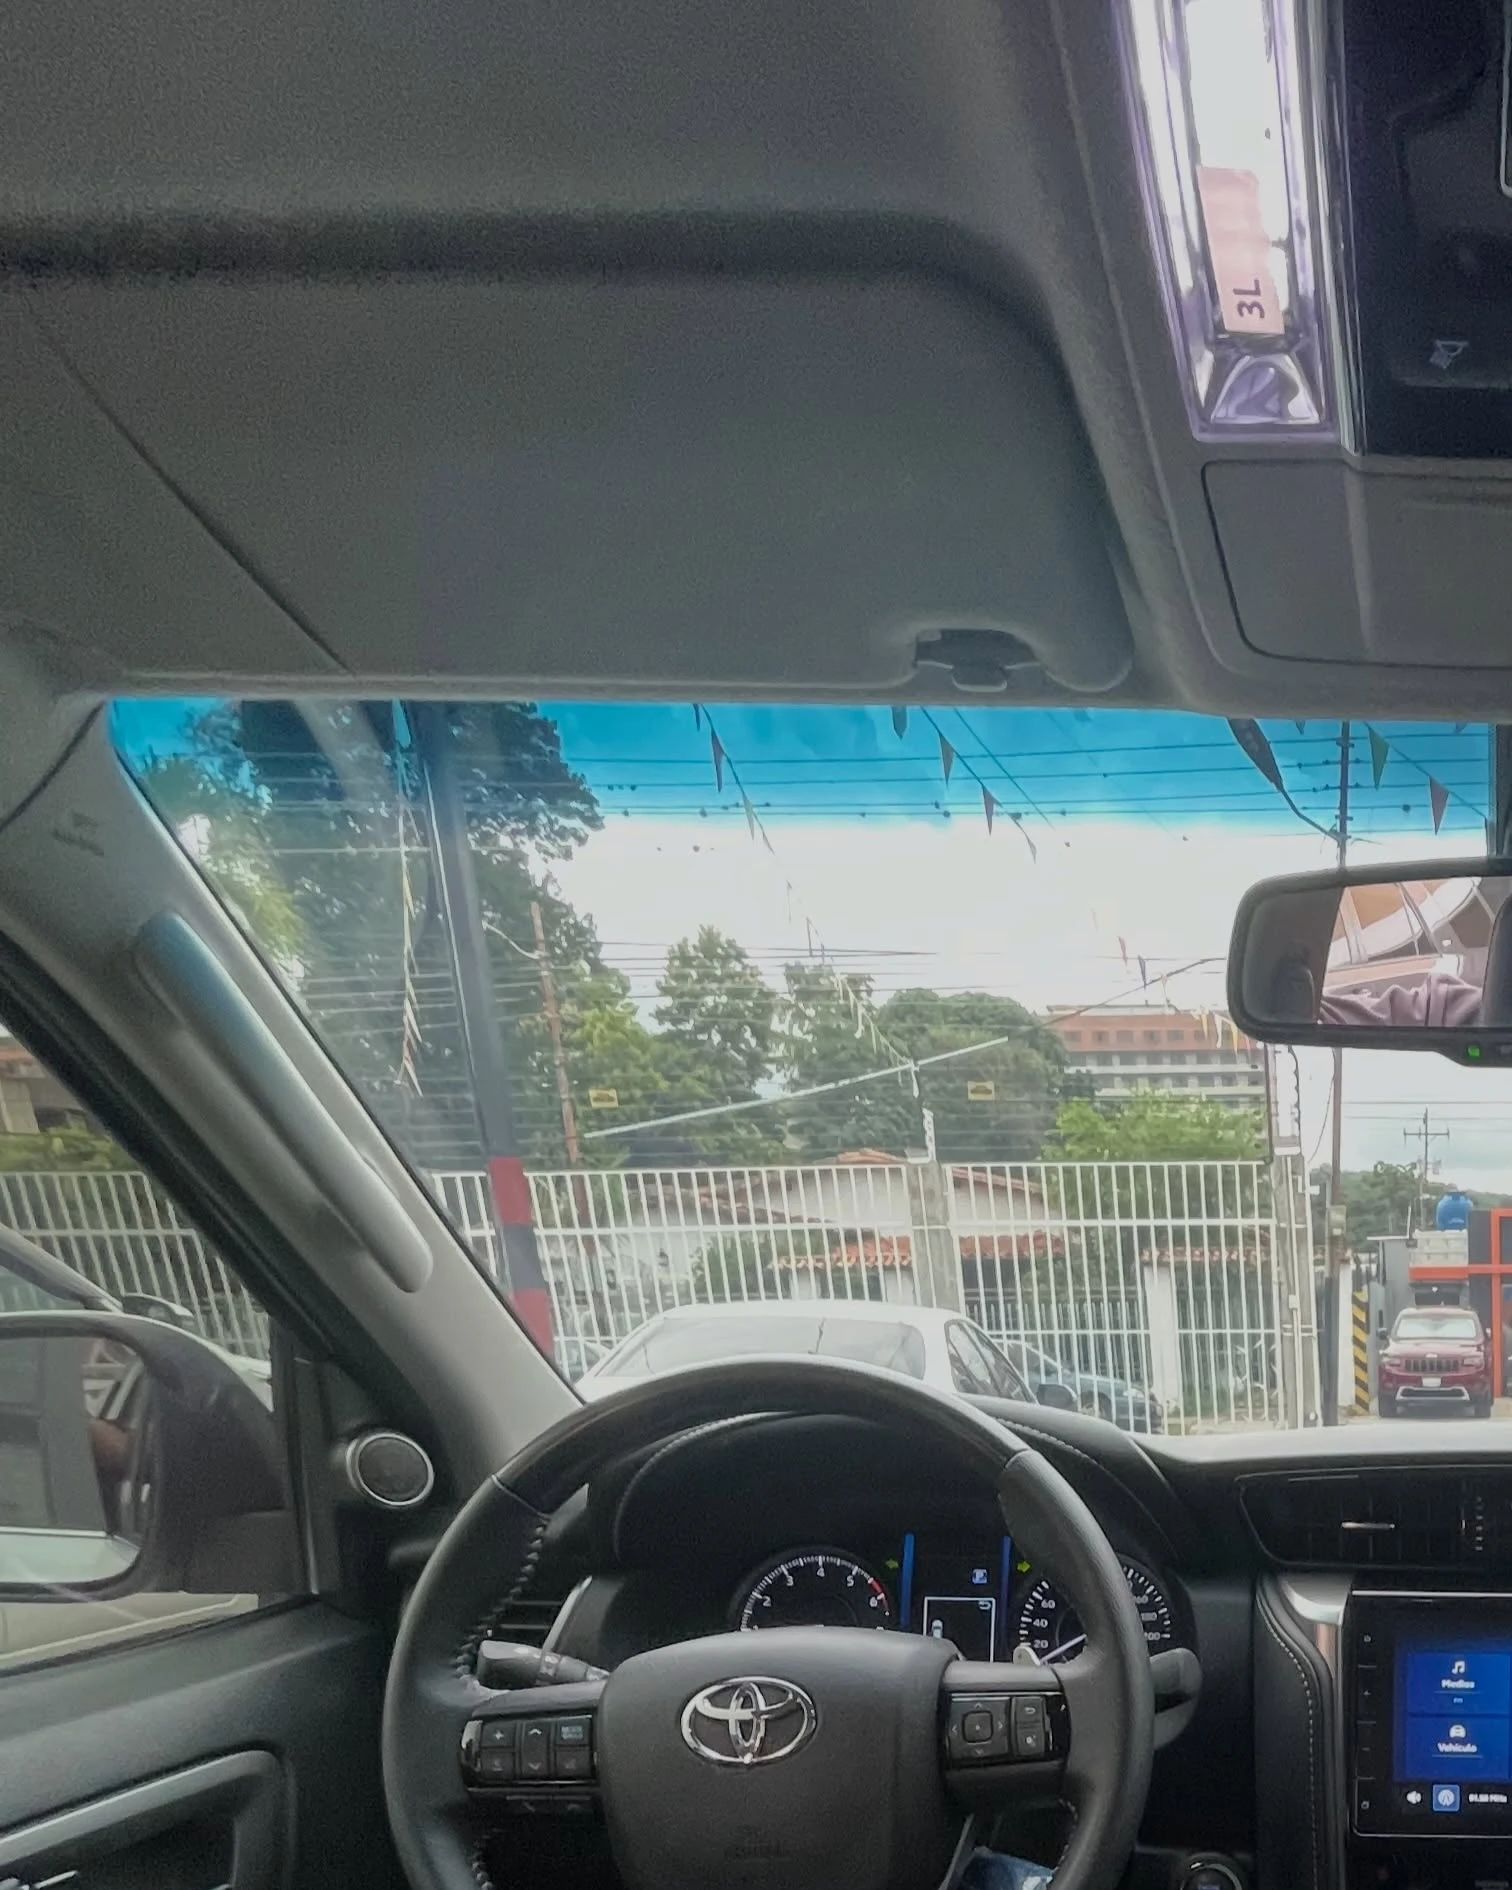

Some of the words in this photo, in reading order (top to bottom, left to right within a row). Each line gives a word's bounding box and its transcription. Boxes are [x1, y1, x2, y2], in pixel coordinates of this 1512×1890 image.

[816, 1567, 825, 1577] 4
[786, 1576, 795, 1587] 3
[846, 1576, 855, 1587] 5
[763, 1596, 772, 1607] 2
[869, 1597, 878, 1608] 6
[1041, 1599, 1056, 1609] 60
[1032, 1618, 1048, 1628] 40
[1033, 1640, 1049, 1649] 20
[1441, 1679, 1476, 1689] Medios
